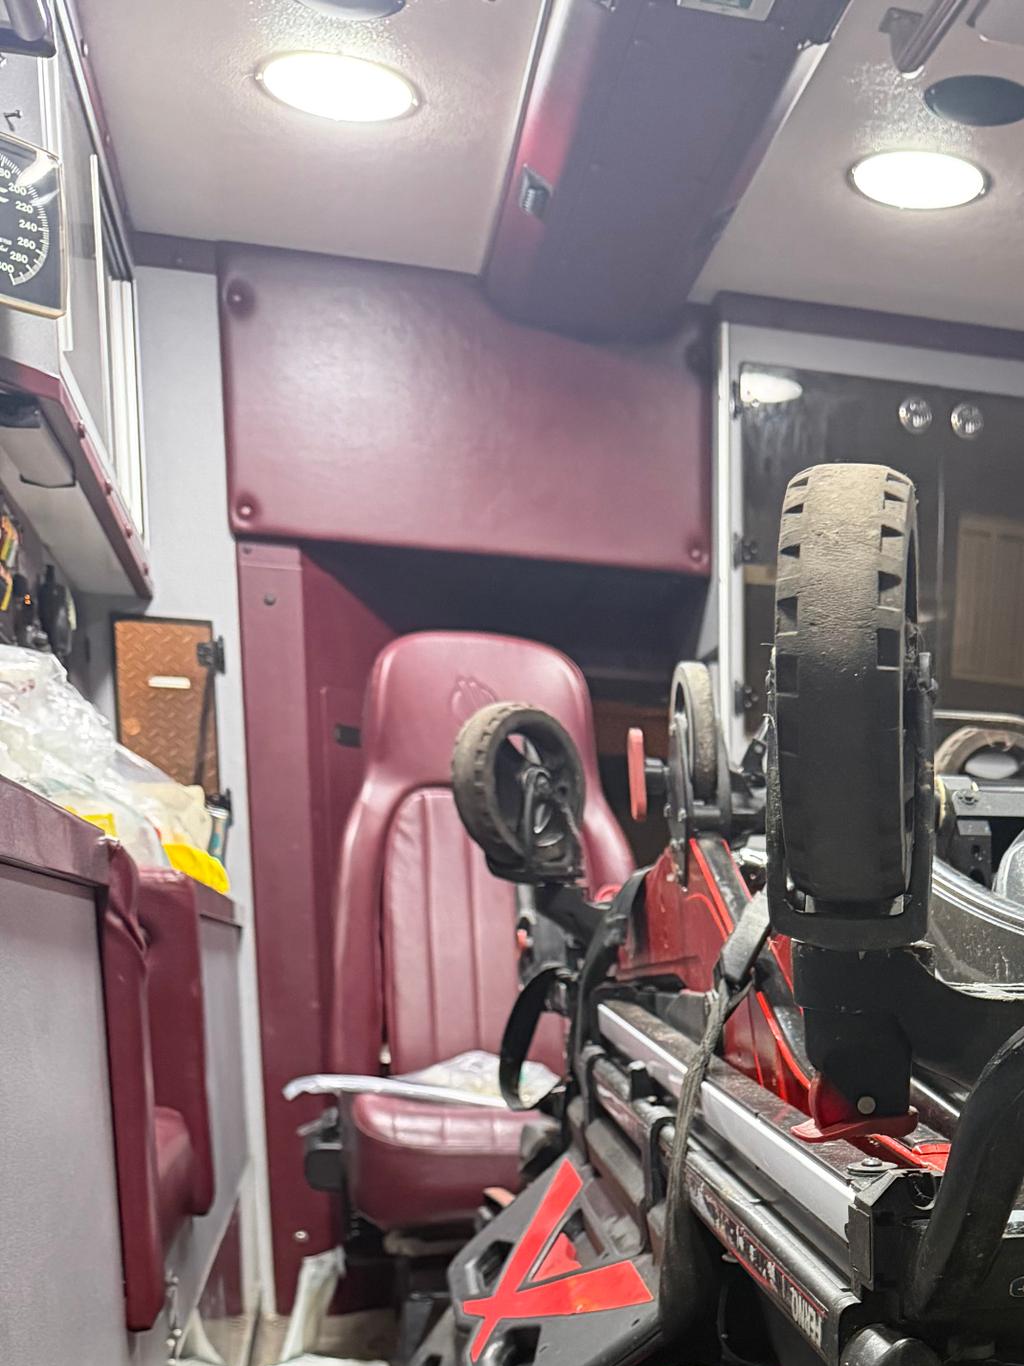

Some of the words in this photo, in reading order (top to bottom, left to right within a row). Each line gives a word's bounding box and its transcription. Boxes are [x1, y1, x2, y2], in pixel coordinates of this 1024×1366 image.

[8, 182, 27, 195] 200
[15, 201, 34, 214] 220
[19, 219, 38, 232] 240
[17, 236, 36, 250] 260
[9, 251, 29, 264] 280
